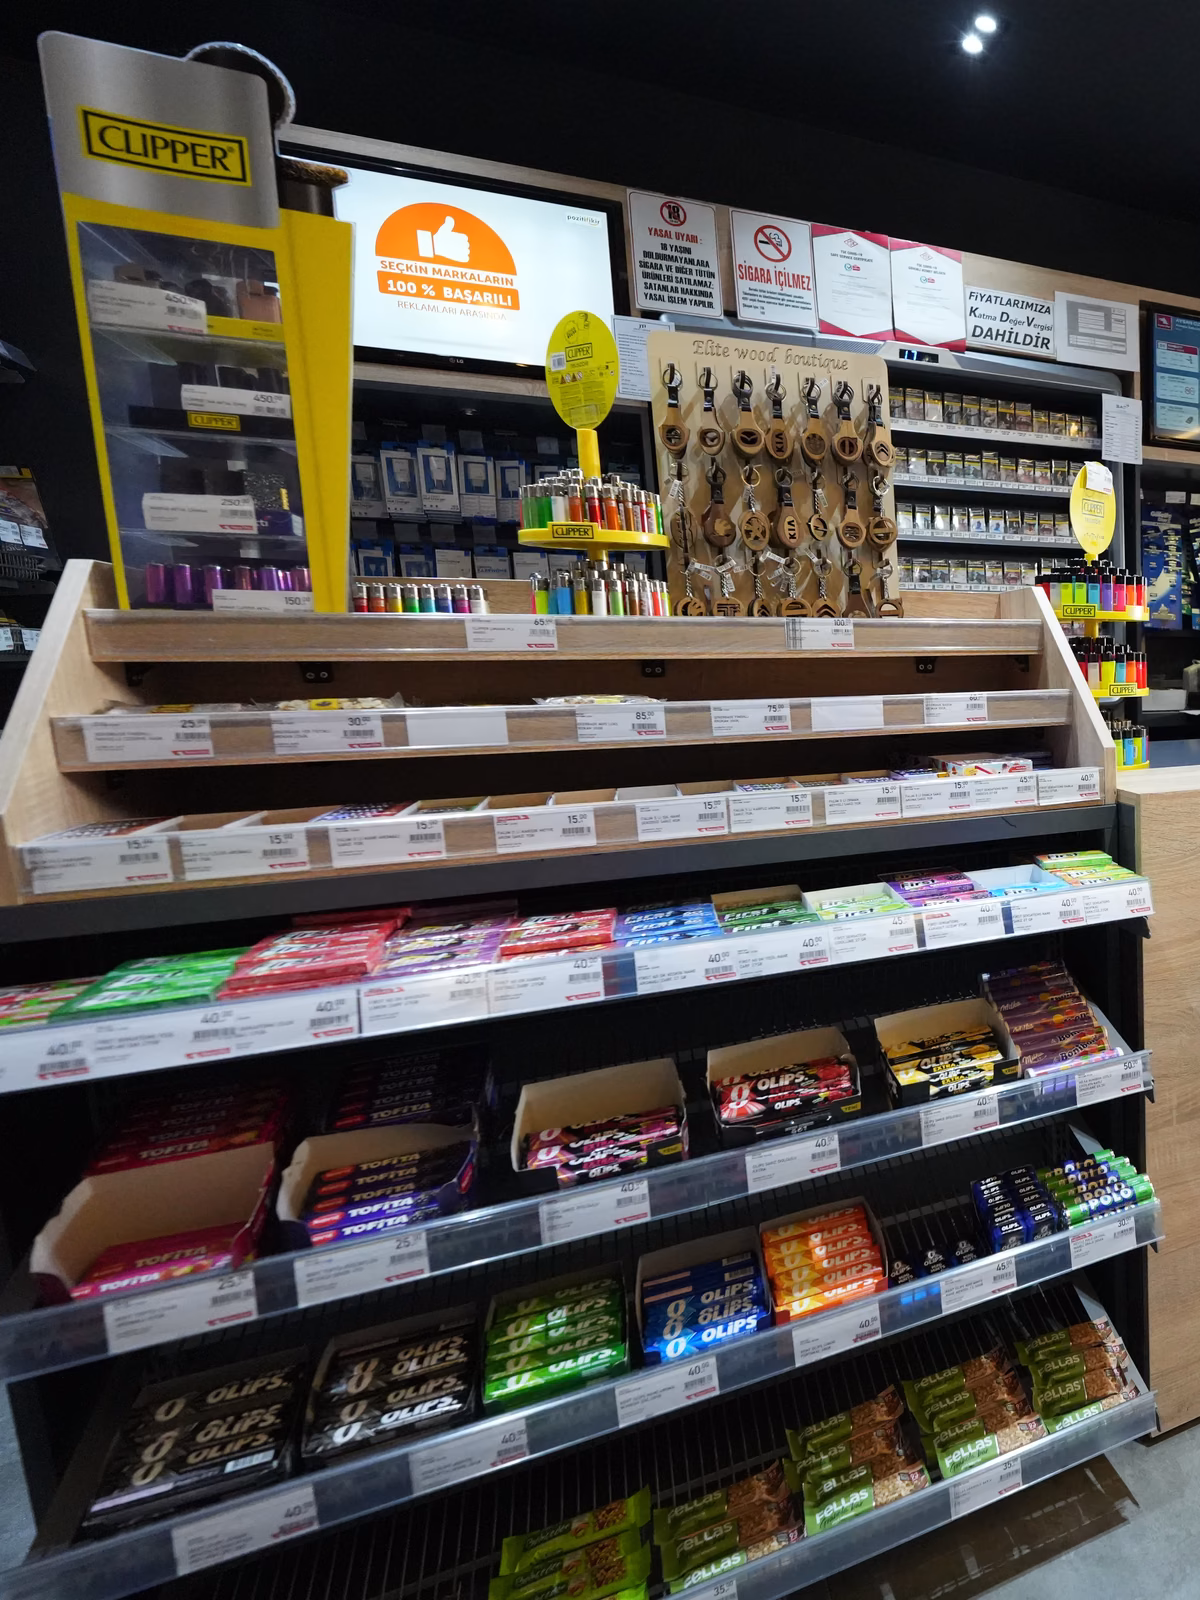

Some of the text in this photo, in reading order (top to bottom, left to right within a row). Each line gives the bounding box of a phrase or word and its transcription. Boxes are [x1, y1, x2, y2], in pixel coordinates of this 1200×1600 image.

[98, 124, 231, 172] CLIPPER
[648, 227, 673, 240] YASAL
[660, 243, 691, 255] 18 YAŞINI
[639, 260, 663, 272] SİGARA
[665, 264, 673, 273] VE
[675, 263, 693, 276] DİĞER
[643, 251, 710, 268] DOLDURMAYANLARA
[380, 260, 514, 287] SEÇKİN MARKALARIN
[642, 270, 673, 283] ÜRÜNLERİ
[738, 261, 811, 291] SİGARA İÇİLMEZ
[388, 280, 512, 307] 100 % BAŞARILI
[644, 282, 713, 299] SATANLAR HAKKINDA
[644, 292, 665, 303] YASAL
[667, 293, 688, 306] İŞLEM
[397, 301, 506, 321] REKLAMLARI ARASINDA
[969, 306, 1053, 332] Katma Değer Vergisi
[972, 324, 1050, 350] DAHİLDİR
[567, 346, 591, 361] CLIPPER
[693, 340, 849, 374] Elite wood boutique
[193, 415, 238, 427] CLIPPER
[774, 432, 785, 455] KIA
[555, 527, 590, 538] CLIPPER
[1065, 607, 1095, 616] CLIPPER
[1111, 685, 1136, 694] CLIPPER
[1089, 1189, 1132, 1211] POLO
